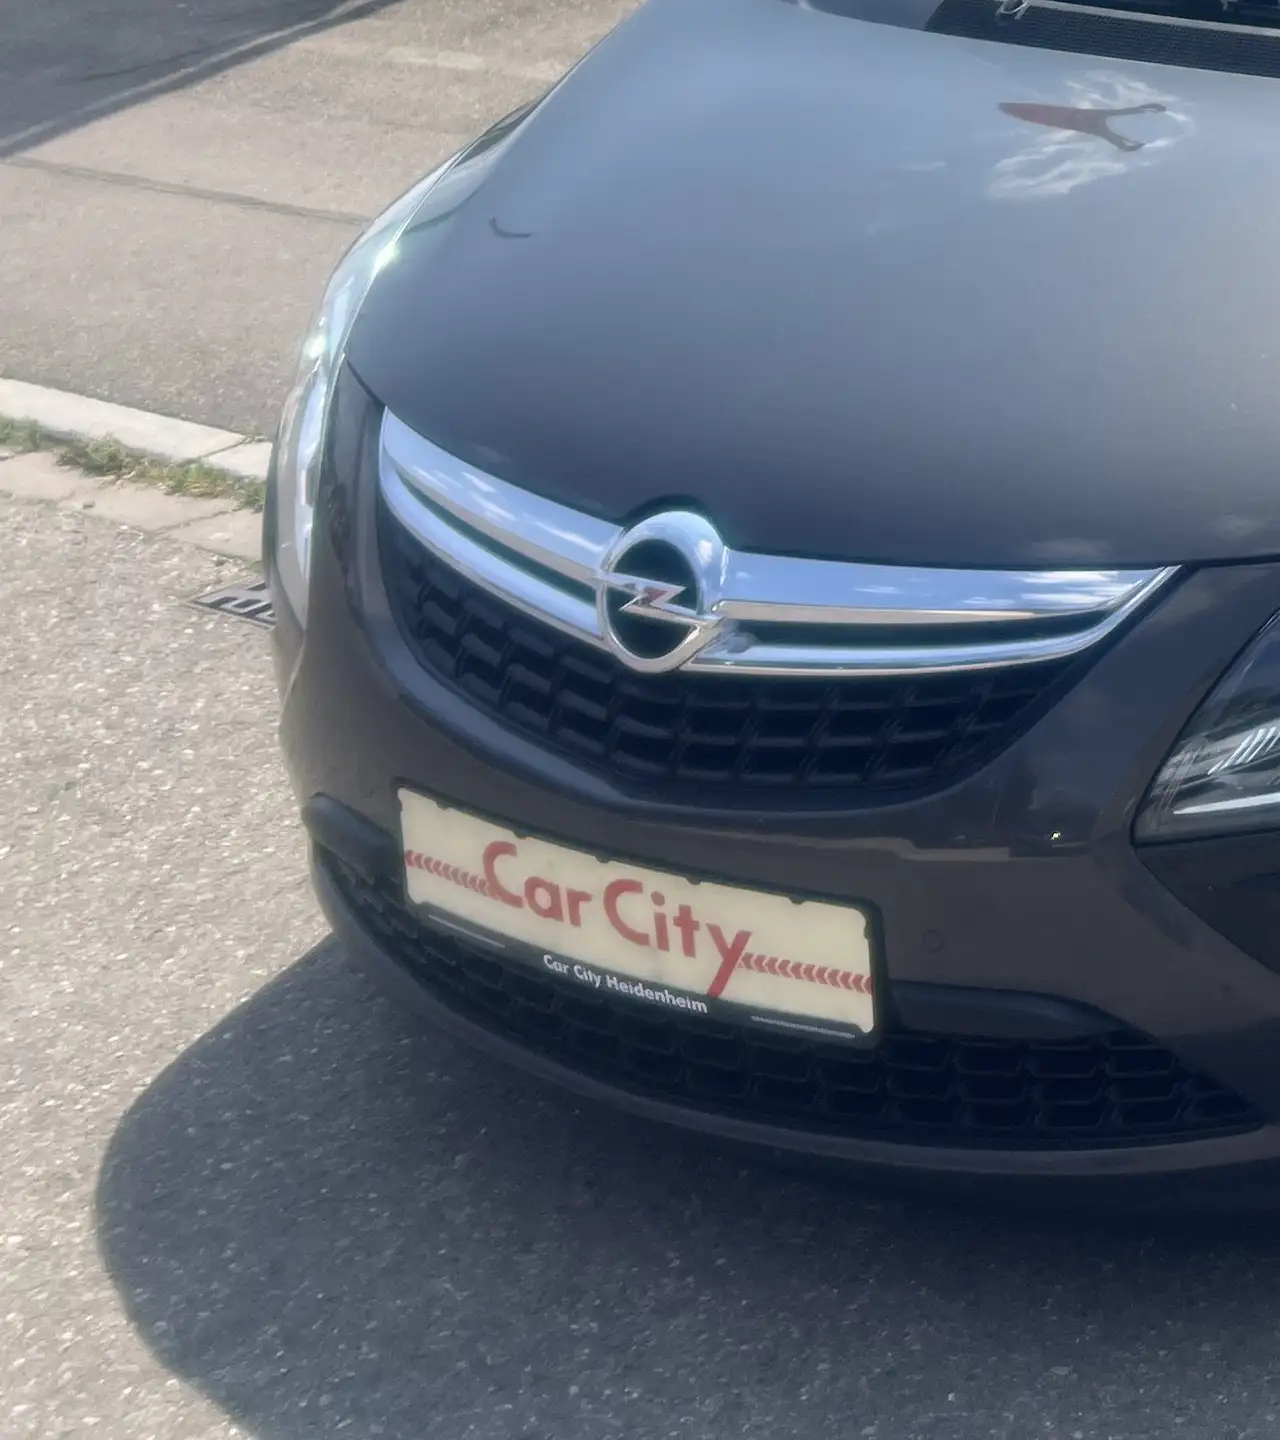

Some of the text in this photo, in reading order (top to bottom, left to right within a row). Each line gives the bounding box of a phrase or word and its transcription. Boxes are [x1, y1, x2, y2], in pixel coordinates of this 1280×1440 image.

[543, 954, 708, 1013] Car City Heidenheim
